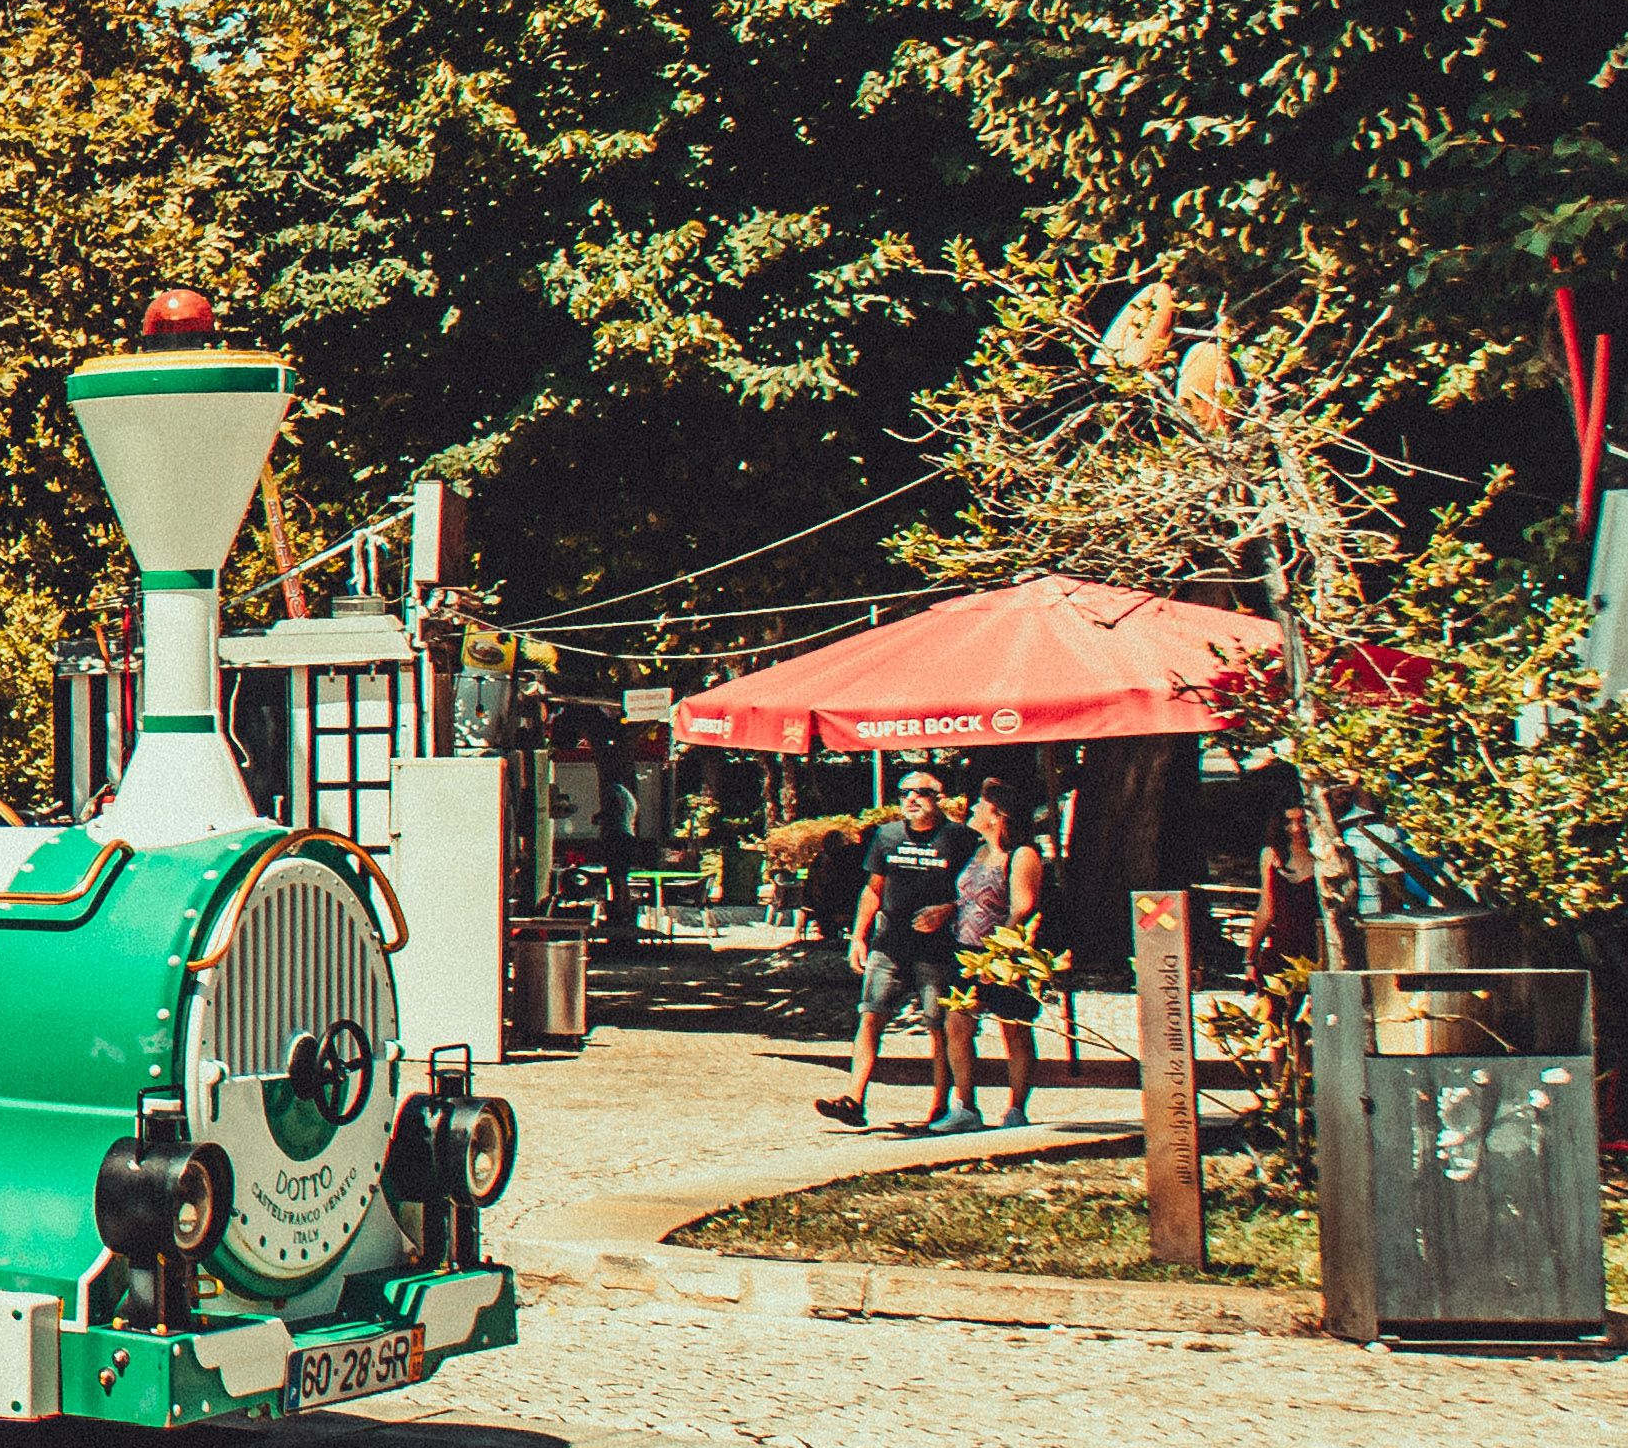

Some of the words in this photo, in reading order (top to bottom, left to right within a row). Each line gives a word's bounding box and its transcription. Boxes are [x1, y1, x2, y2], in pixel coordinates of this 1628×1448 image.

[856, 718, 921, 740] SUPER
[925, 714, 983, 735] BOCK
[1158, 954, 1184, 1053] mirandela
[1164, 1058, 1185, 1084] de
[275, 1164, 333, 1202] DOTTO
[251, 1181, 321, 1226] CASTELFRANCO
[293, 1228, 320, 1245] ITALY
